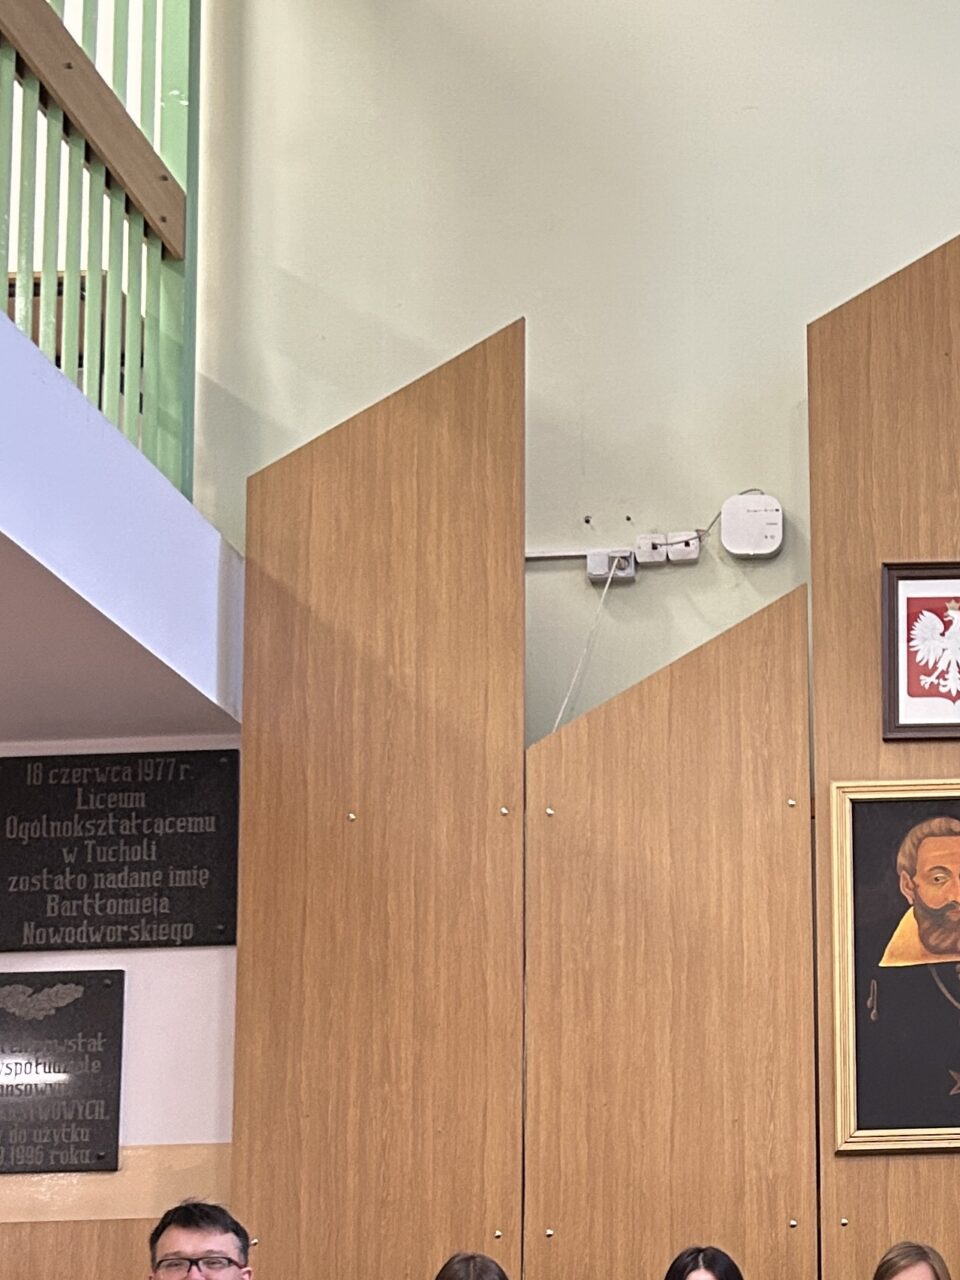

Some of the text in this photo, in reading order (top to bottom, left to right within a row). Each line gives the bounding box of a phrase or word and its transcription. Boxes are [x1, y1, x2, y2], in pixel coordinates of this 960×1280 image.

[26, 762, 43, 786] 18
[49, 764, 132, 785] czerwca
[137, 758, 176, 782] 1977
[75, 787, 146, 810] Liceum
[62, 838, 157, 864] w Tucholi
[8, 867, 87, 892] zostało
[93, 866, 163, 889] nadane
[22, 918, 194, 945] Nowodworskiego
